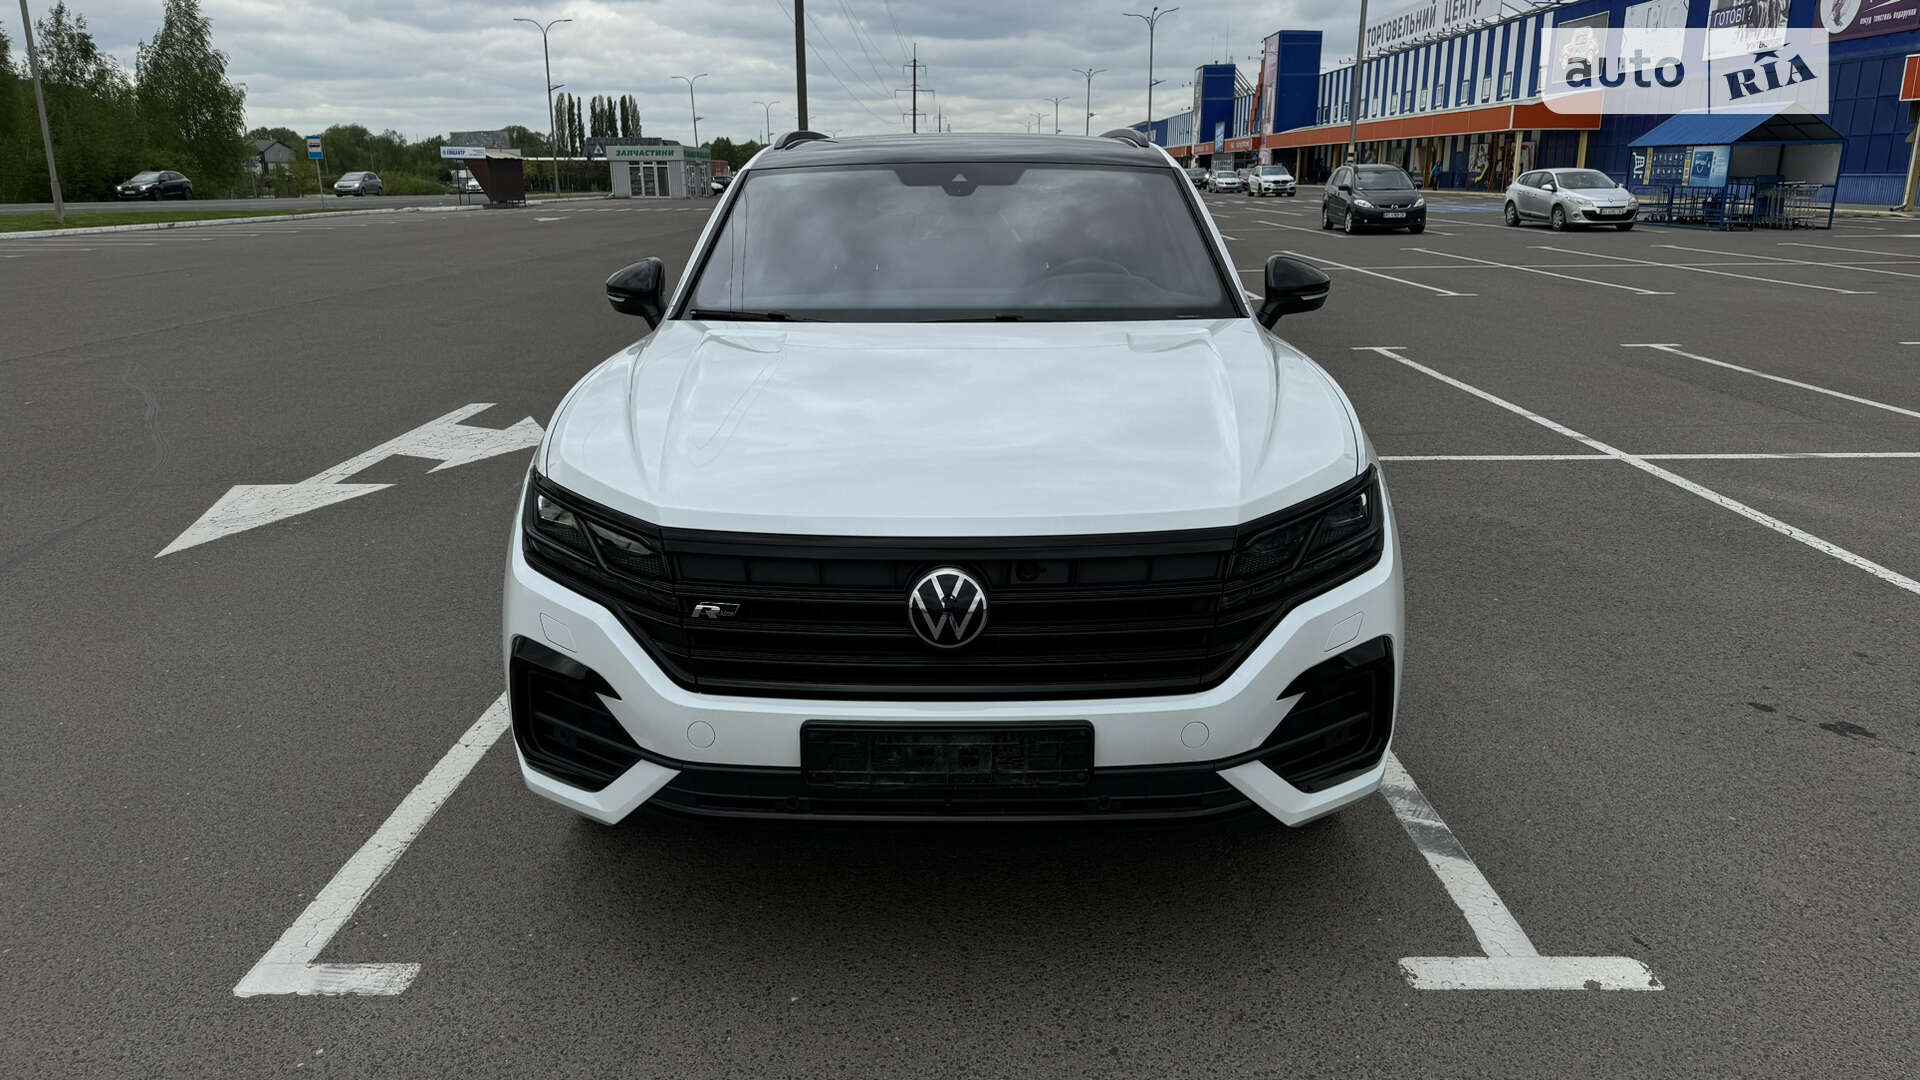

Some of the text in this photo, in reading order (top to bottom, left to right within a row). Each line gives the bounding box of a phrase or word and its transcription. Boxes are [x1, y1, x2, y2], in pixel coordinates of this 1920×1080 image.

[1366, 0, 1437, 48] ТОРГОВЕЛЬНИЙ
[1713, 7, 1746, 28] ГОТОВІ
[616, 149, 674, 157] ЗАПЧАСТИНИ
